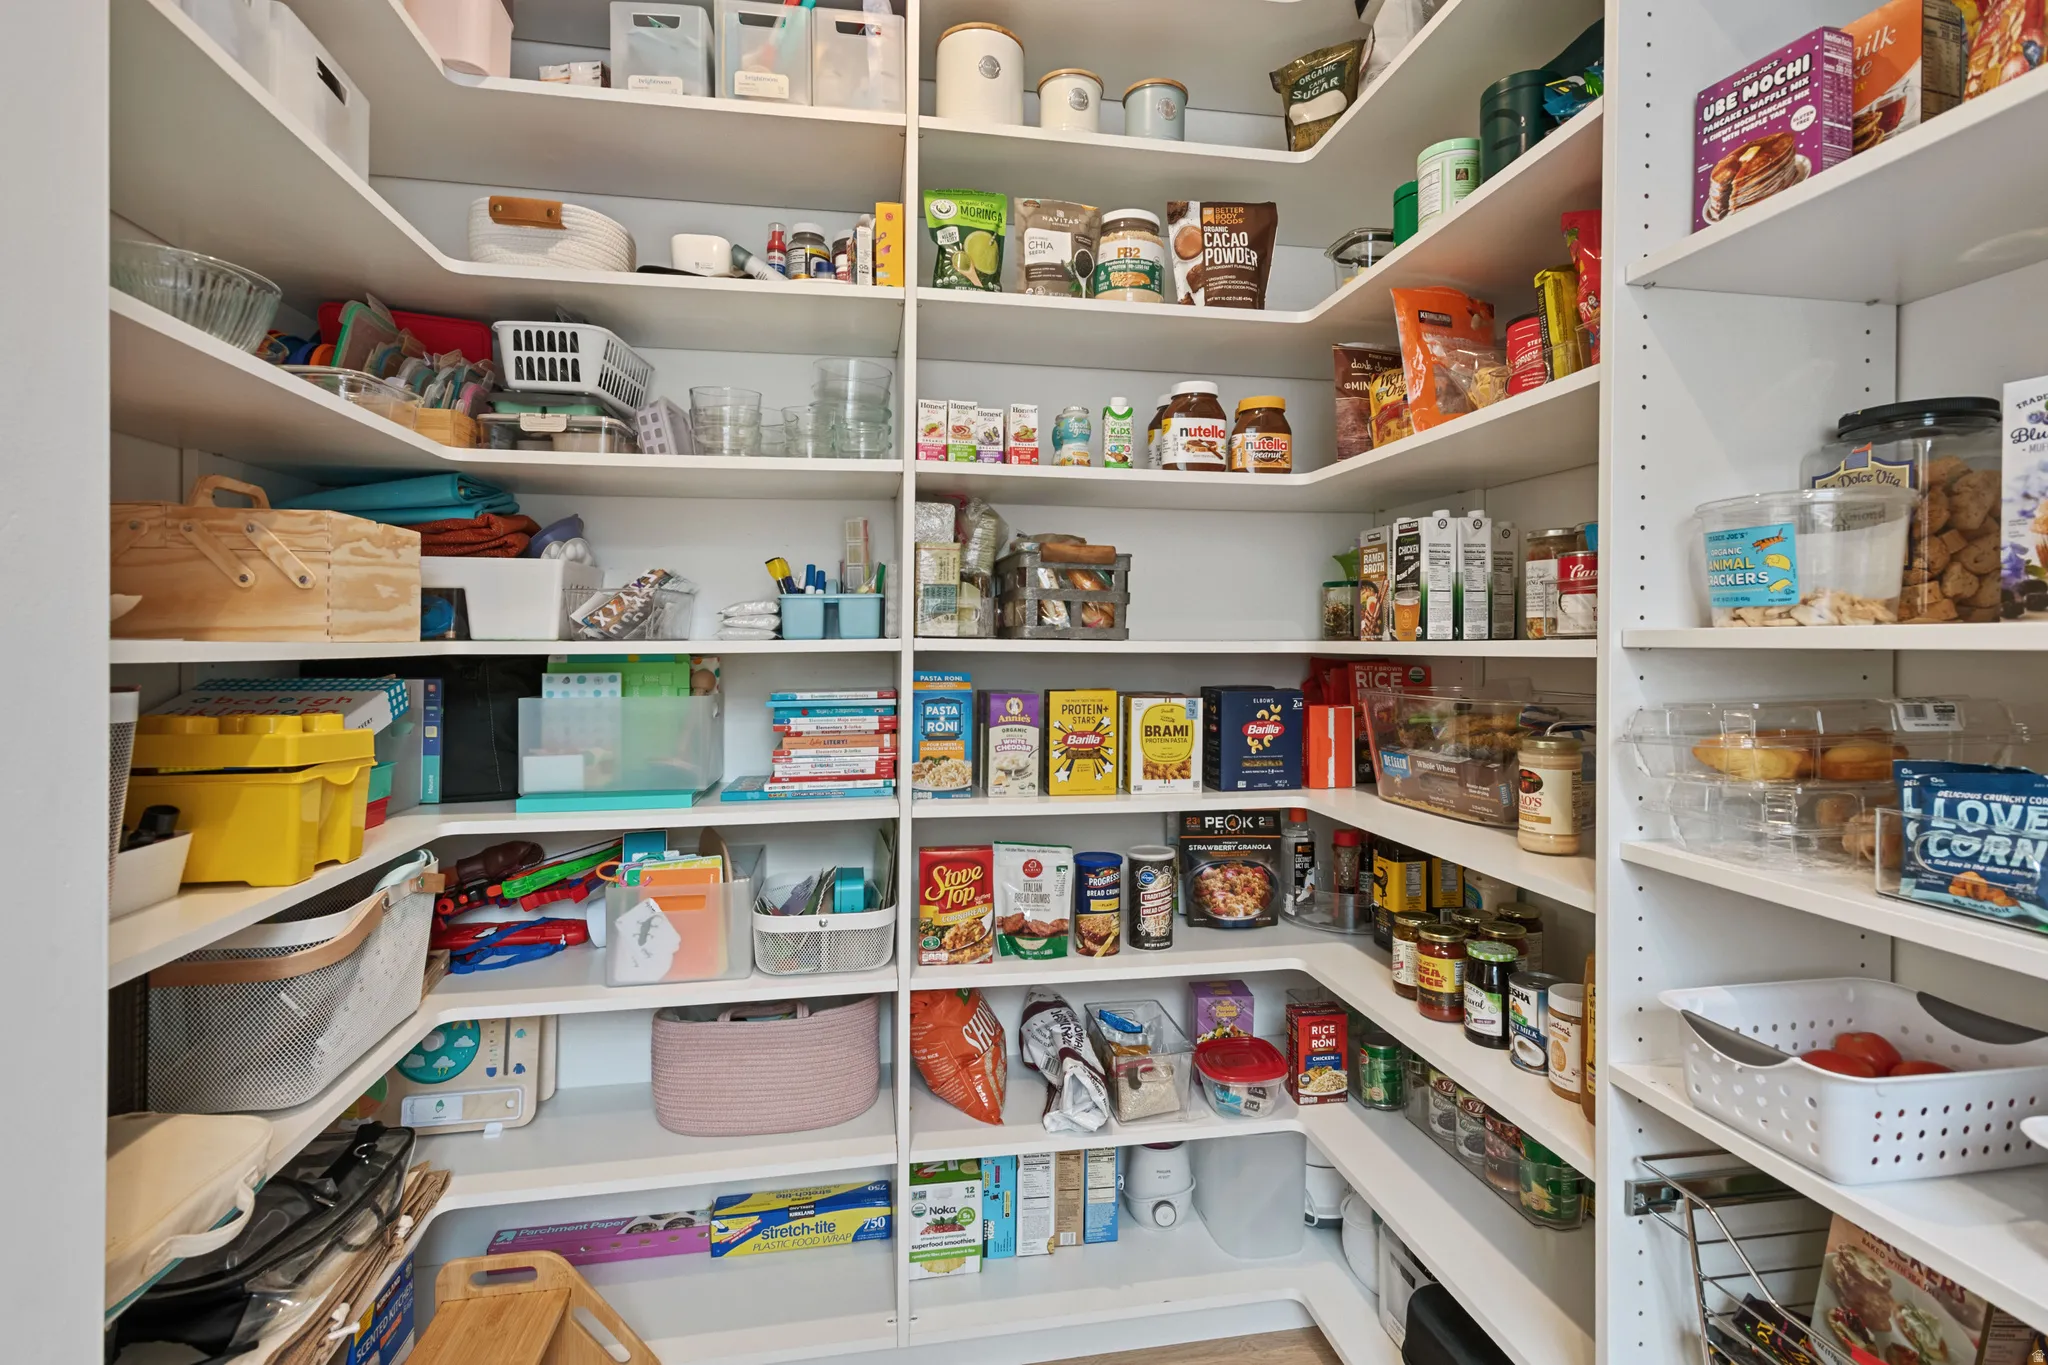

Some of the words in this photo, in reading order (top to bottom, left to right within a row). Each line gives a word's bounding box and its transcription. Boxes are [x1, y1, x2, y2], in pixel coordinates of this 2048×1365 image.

[1299, 63, 1337, 86] ORGANIC
[1733, 72, 1757, 88] TRADER
[1292, 76, 1339, 100] SUGAR
[1703, 91, 1738, 122] UBE
[1742, 54, 1811, 102] MOCHI
[1704, 110, 1742, 135] PANCAKE
[1751, 87, 1787, 112] WAFFLE
[1791, 77, 1809, 91] MIX
[1710, 127, 1732, 142] CHEWY
[1734, 115, 1756, 131] MOCHI
[1758, 97, 1792, 119] PANCAKE
[1794, 89, 1810, 101] MIX
[1793, 111, 1814, 122] GLUTEN
[1796, 117, 1811, 126] FREE
[1722, 130, 1740, 142] WITH
[1741, 119, 1767, 134] PURPLE
[960, 206, 1003, 223] MORINGA
[1042, 215, 1079, 225] NAVITAS
[1028, 240, 1053, 250] CHIA
[1204, 232, 1248, 247] CACAO
[1117, 247, 1140, 259] PB2
[1205, 248, 1258, 267] POWDER
[1351, 359, 1373, 370] dark
[920, 402, 945, 410] Honest
[951, 402, 975, 411] Honest
[1180, 426, 1226, 438] nutella
[1246, 440, 1287, 450] nutella
[1251, 451, 1282, 460] peanut
[1838, 472, 1874, 488] Dolce
[1875, 469, 1902, 488] Vita
[1726, 532, 1745, 540] JOE'S
[1398, 544, 1419, 556] CHICKEN
[1711, 547, 1742, 556] ORGANIC
[1364, 552, 1384, 563] RAMEN
[1364, 562, 1384, 574] BROTH
[1709, 557, 1755, 571] ANIMAL
[1397, 570, 1408, 581] BONE
[1708, 571, 1769, 586] RACKERS
[1356, 672, 1402, 688] RICE
[926, 706, 958, 715] PASTA
[1062, 704, 1109, 715] PROTEIN+
[998, 714, 1031, 723] Annie's
[927, 721, 958, 732] RONI
[1145, 725, 1189, 736] BRAMI
[1247, 725, 1280, 735] Barilla
[1066, 734, 1100, 745] Barilla
[1417, 761, 1435, 770] Whole
[1436, 763, 1456, 774] Wheat
[1937, 790, 1982, 800] DELICIOUS
[1983, 793, 2026, 804] CRUNCHY
[1931, 798, 2048, 835] LOVE
[1927, 830, 2048, 868] CORN
[925, 865, 984, 901] Stove
[1023, 882, 1042, 892] ITALIAN
[943, 887, 976, 910] Top
[1014, 893, 1030, 904] BREAD
[1030, 894, 1050, 904] CRUMBS
[1086, 889, 1104, 897] BREAD
[941, 906, 988, 923] CORNBREAD
[1312, 1025, 1335, 1035] RICE
[1522, 1027, 1538, 1038] MILK
[1312, 1039, 1336, 1048] RONI
[965, 1186, 975, 1194] 12
[789, 1210, 815, 1218] KIRKLAND
[929, 1206, 957, 1215] Noka
[518, 1222, 589, 1239] Parchment
[590, 1218, 627, 1230] Paper
[863, 1216, 886, 1229] 750
[761, 1221, 836, 1240] stretch-tite
[752, 1239, 790, 1251] PLASTIC
[792, 1236, 820, 1247] FOOD
[822, 1233, 852, 1244] WRAP
[911, 1240, 943, 1250] superfood
[944, 1238, 975, 1247] smoothies
[1862, 1237, 1885, 1259] BAKED
[356, 1316, 388, 1363] SCENTED
